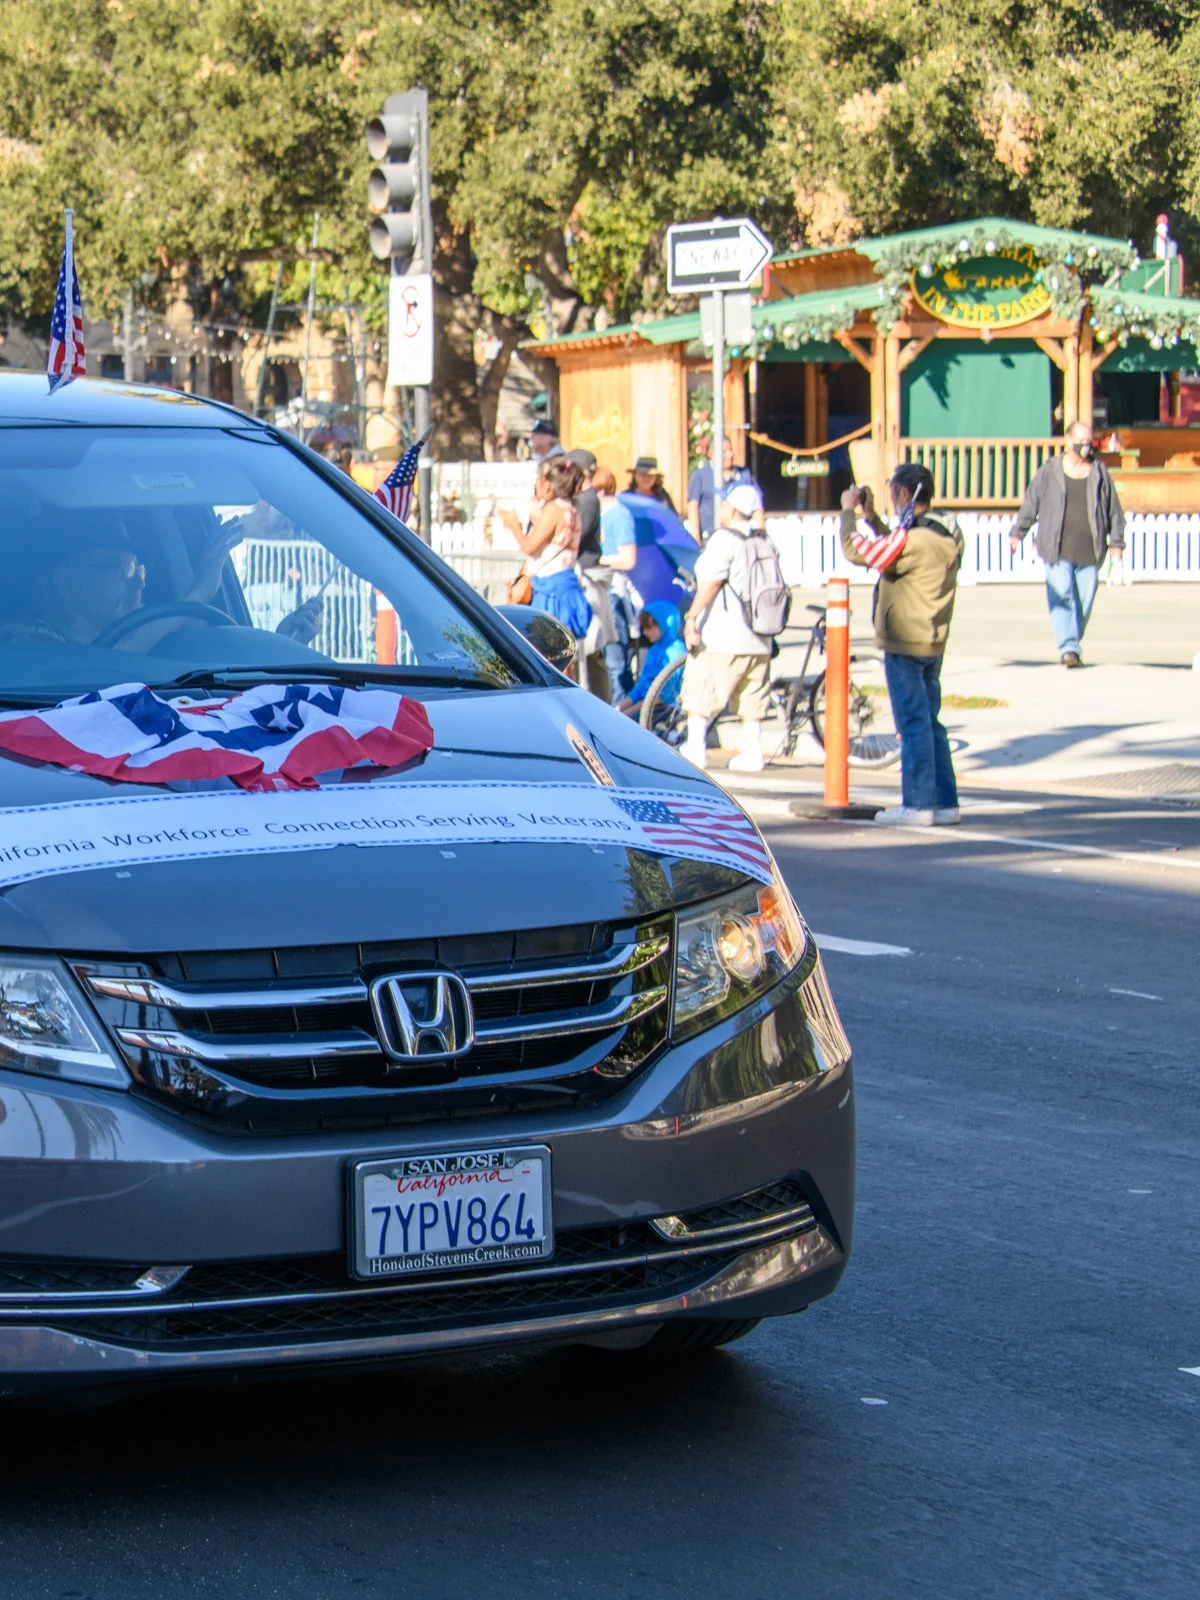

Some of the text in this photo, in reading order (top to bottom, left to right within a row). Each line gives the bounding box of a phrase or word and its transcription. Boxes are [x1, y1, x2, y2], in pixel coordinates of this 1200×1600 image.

[922, 284, 1049, 323] IN THE PARK
[102, 824, 252, 847] Workforce
[264, 814, 415, 836] Connection
[416, 812, 515, 829] Serving
[517, 812, 632, 831] Veterans
[407, 1152, 500, 1175] SAN JOSE
[397, 1169, 513, 1197] California
[371, 1192, 535, 1255] 7YPV864
[371, 1243, 541, 1274] HondaofStevensCreek.com
